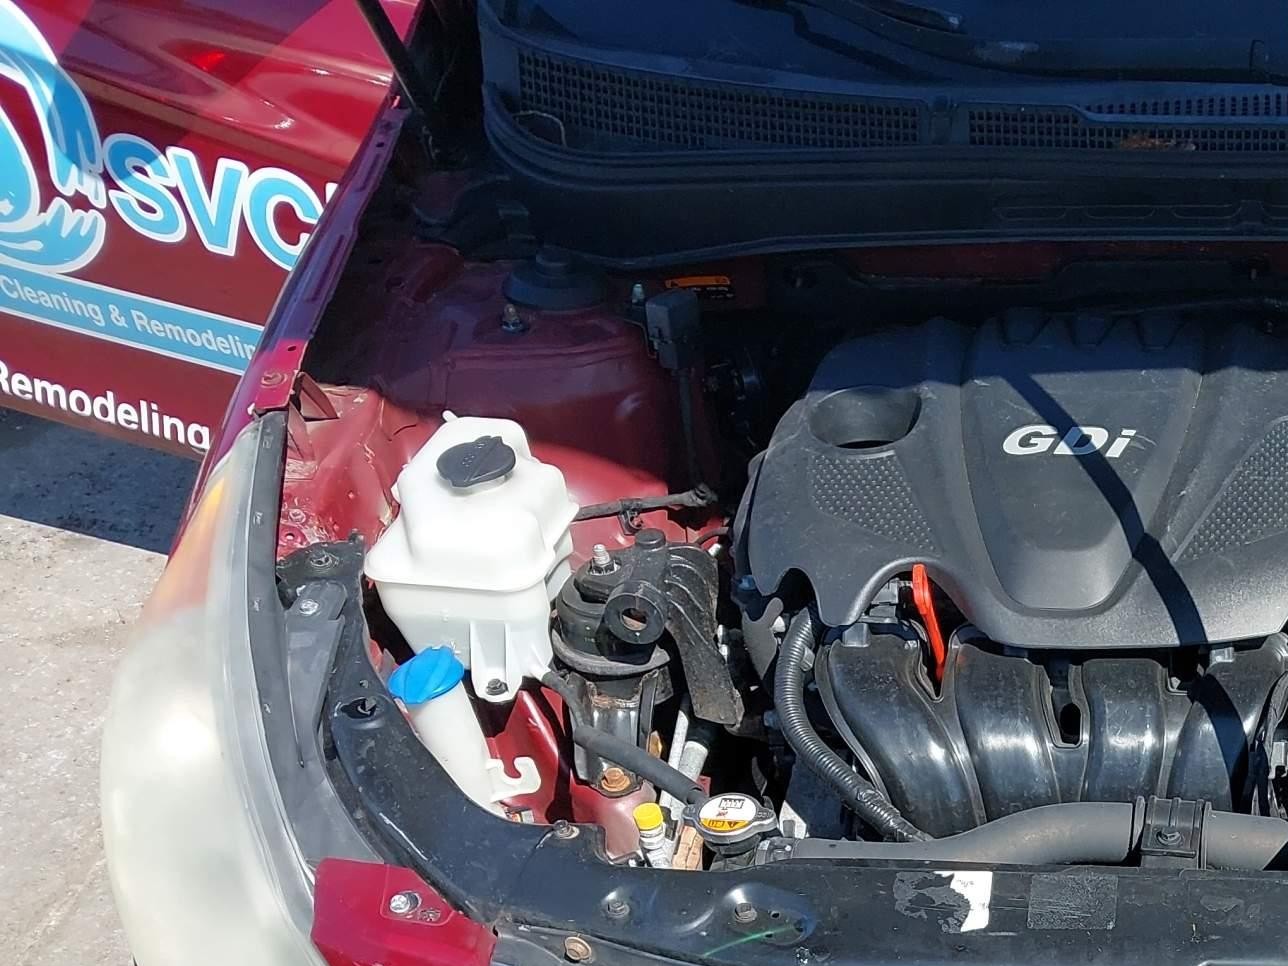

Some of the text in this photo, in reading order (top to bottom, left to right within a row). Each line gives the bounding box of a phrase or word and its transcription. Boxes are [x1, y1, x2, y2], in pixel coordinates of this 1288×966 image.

[104, 134, 338, 271] SVC
[0, 275, 106, 326] Cleaning
[110, 303, 129, 329] &
[1003, 424, 1137, 458] GDi
